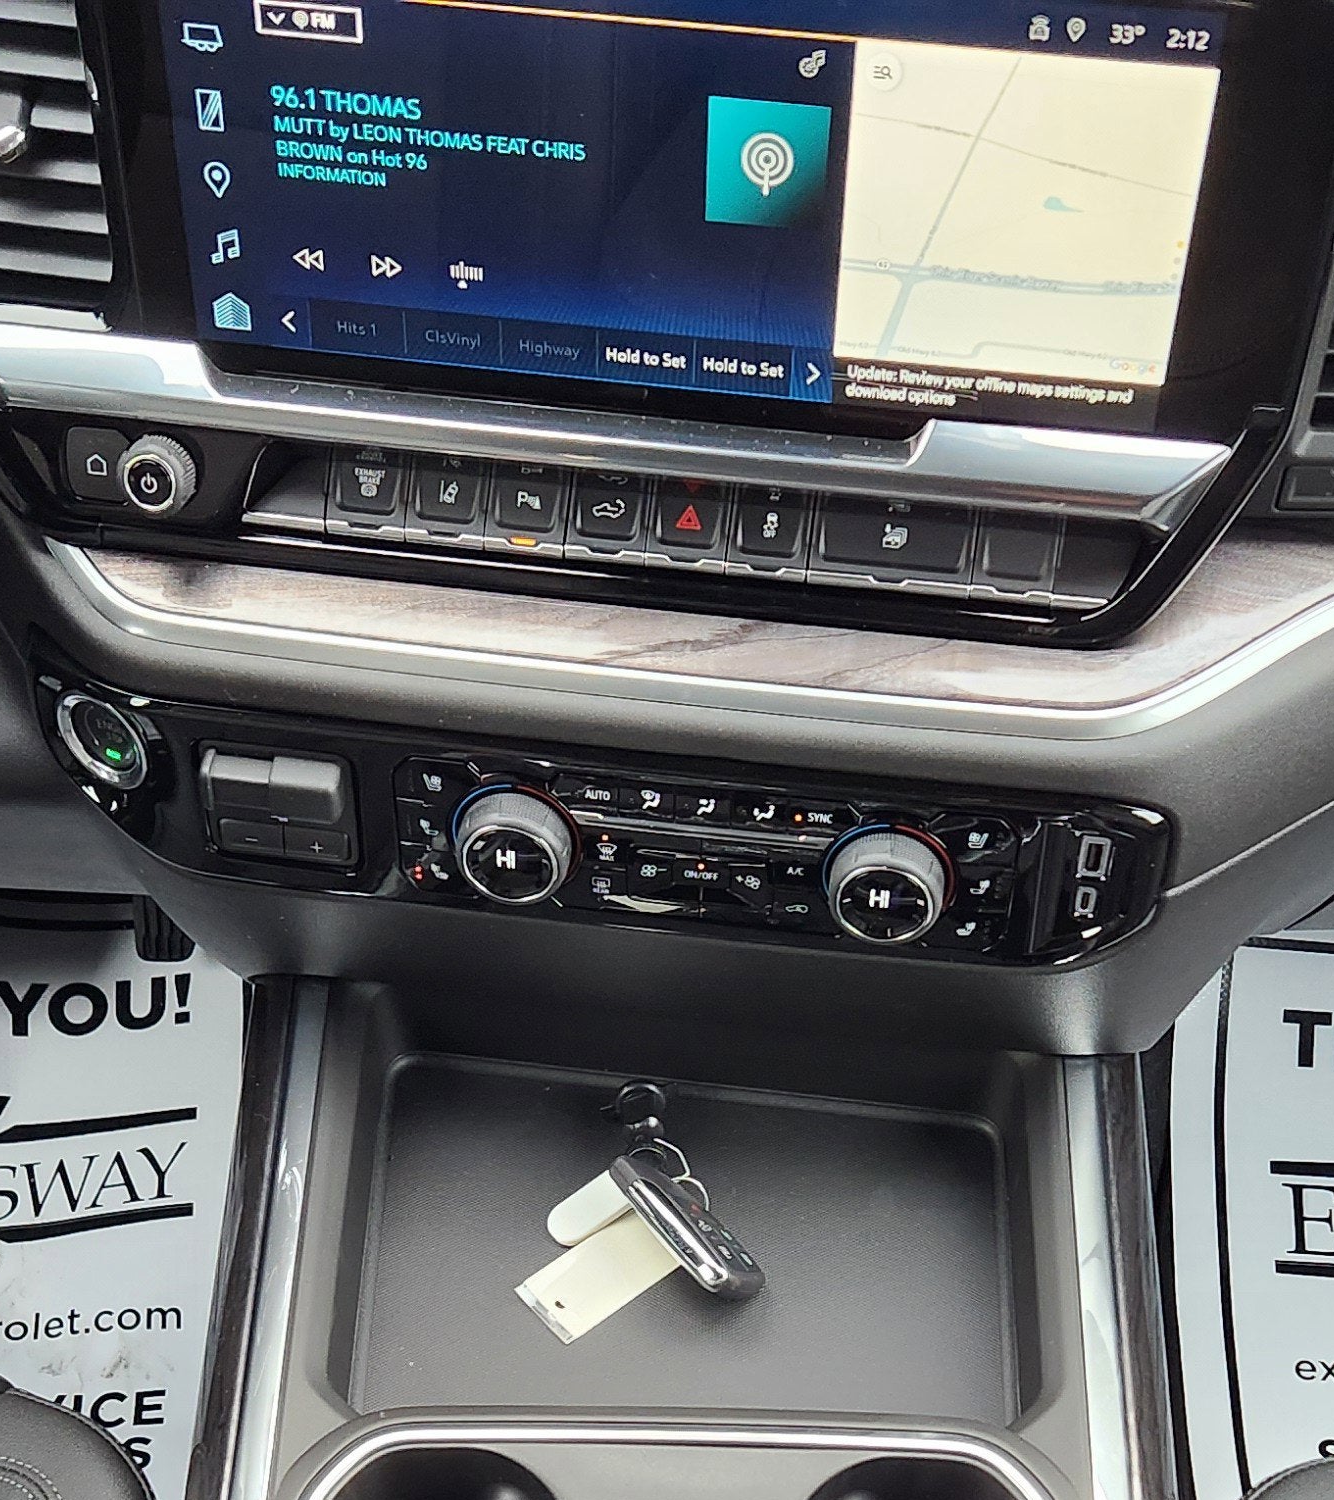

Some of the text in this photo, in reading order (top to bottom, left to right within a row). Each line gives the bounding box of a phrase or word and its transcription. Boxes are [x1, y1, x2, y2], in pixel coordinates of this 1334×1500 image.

[310, 12, 336, 31] FM
[1166, 27, 1211, 52] 2:12
[270, 84, 422, 120] 96.1 THOMAS
[273, 115, 587, 162] MUTT by LEON THOMAS FEAT CHRIS
[275, 139, 428, 171] BROWN on Hot 96
[277, 162, 387, 188] INFORMATION
[336, 320, 378, 337] Hits 1
[425, 329, 481, 350] ClsVinyl
[518, 339, 580, 360] Highway
[605, 346, 687, 371] Hold to Set
[703, 355, 785, 380] Hold to Set
[845, 382, 957, 407] download options
[847, 364, 1135, 405] Update: Review your offline maps settings and
[354, 467, 386, 479] EXHAUST
[584, 789, 611, 801] AUTO
[807, 812, 834, 825] SYNC
[683, 869, 719, 881] ON/OFF
[786, 866, 805, 877] A/C
